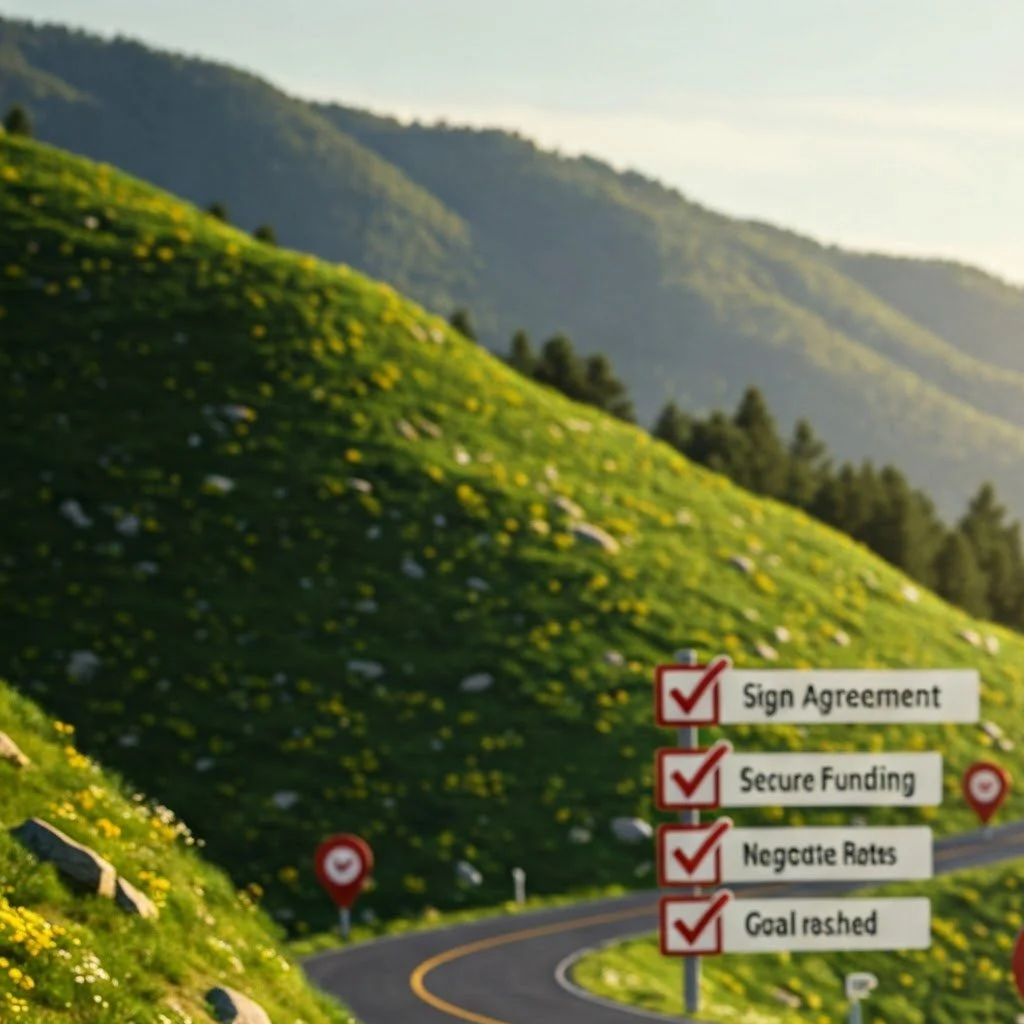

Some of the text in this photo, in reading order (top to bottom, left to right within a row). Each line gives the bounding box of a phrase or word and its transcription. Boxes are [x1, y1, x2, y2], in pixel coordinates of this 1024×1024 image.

[743, 682, 942, 716] Sign Agreement
[740, 766, 916, 797] Secure Funding
[745, 911, 796, 937] Goal
